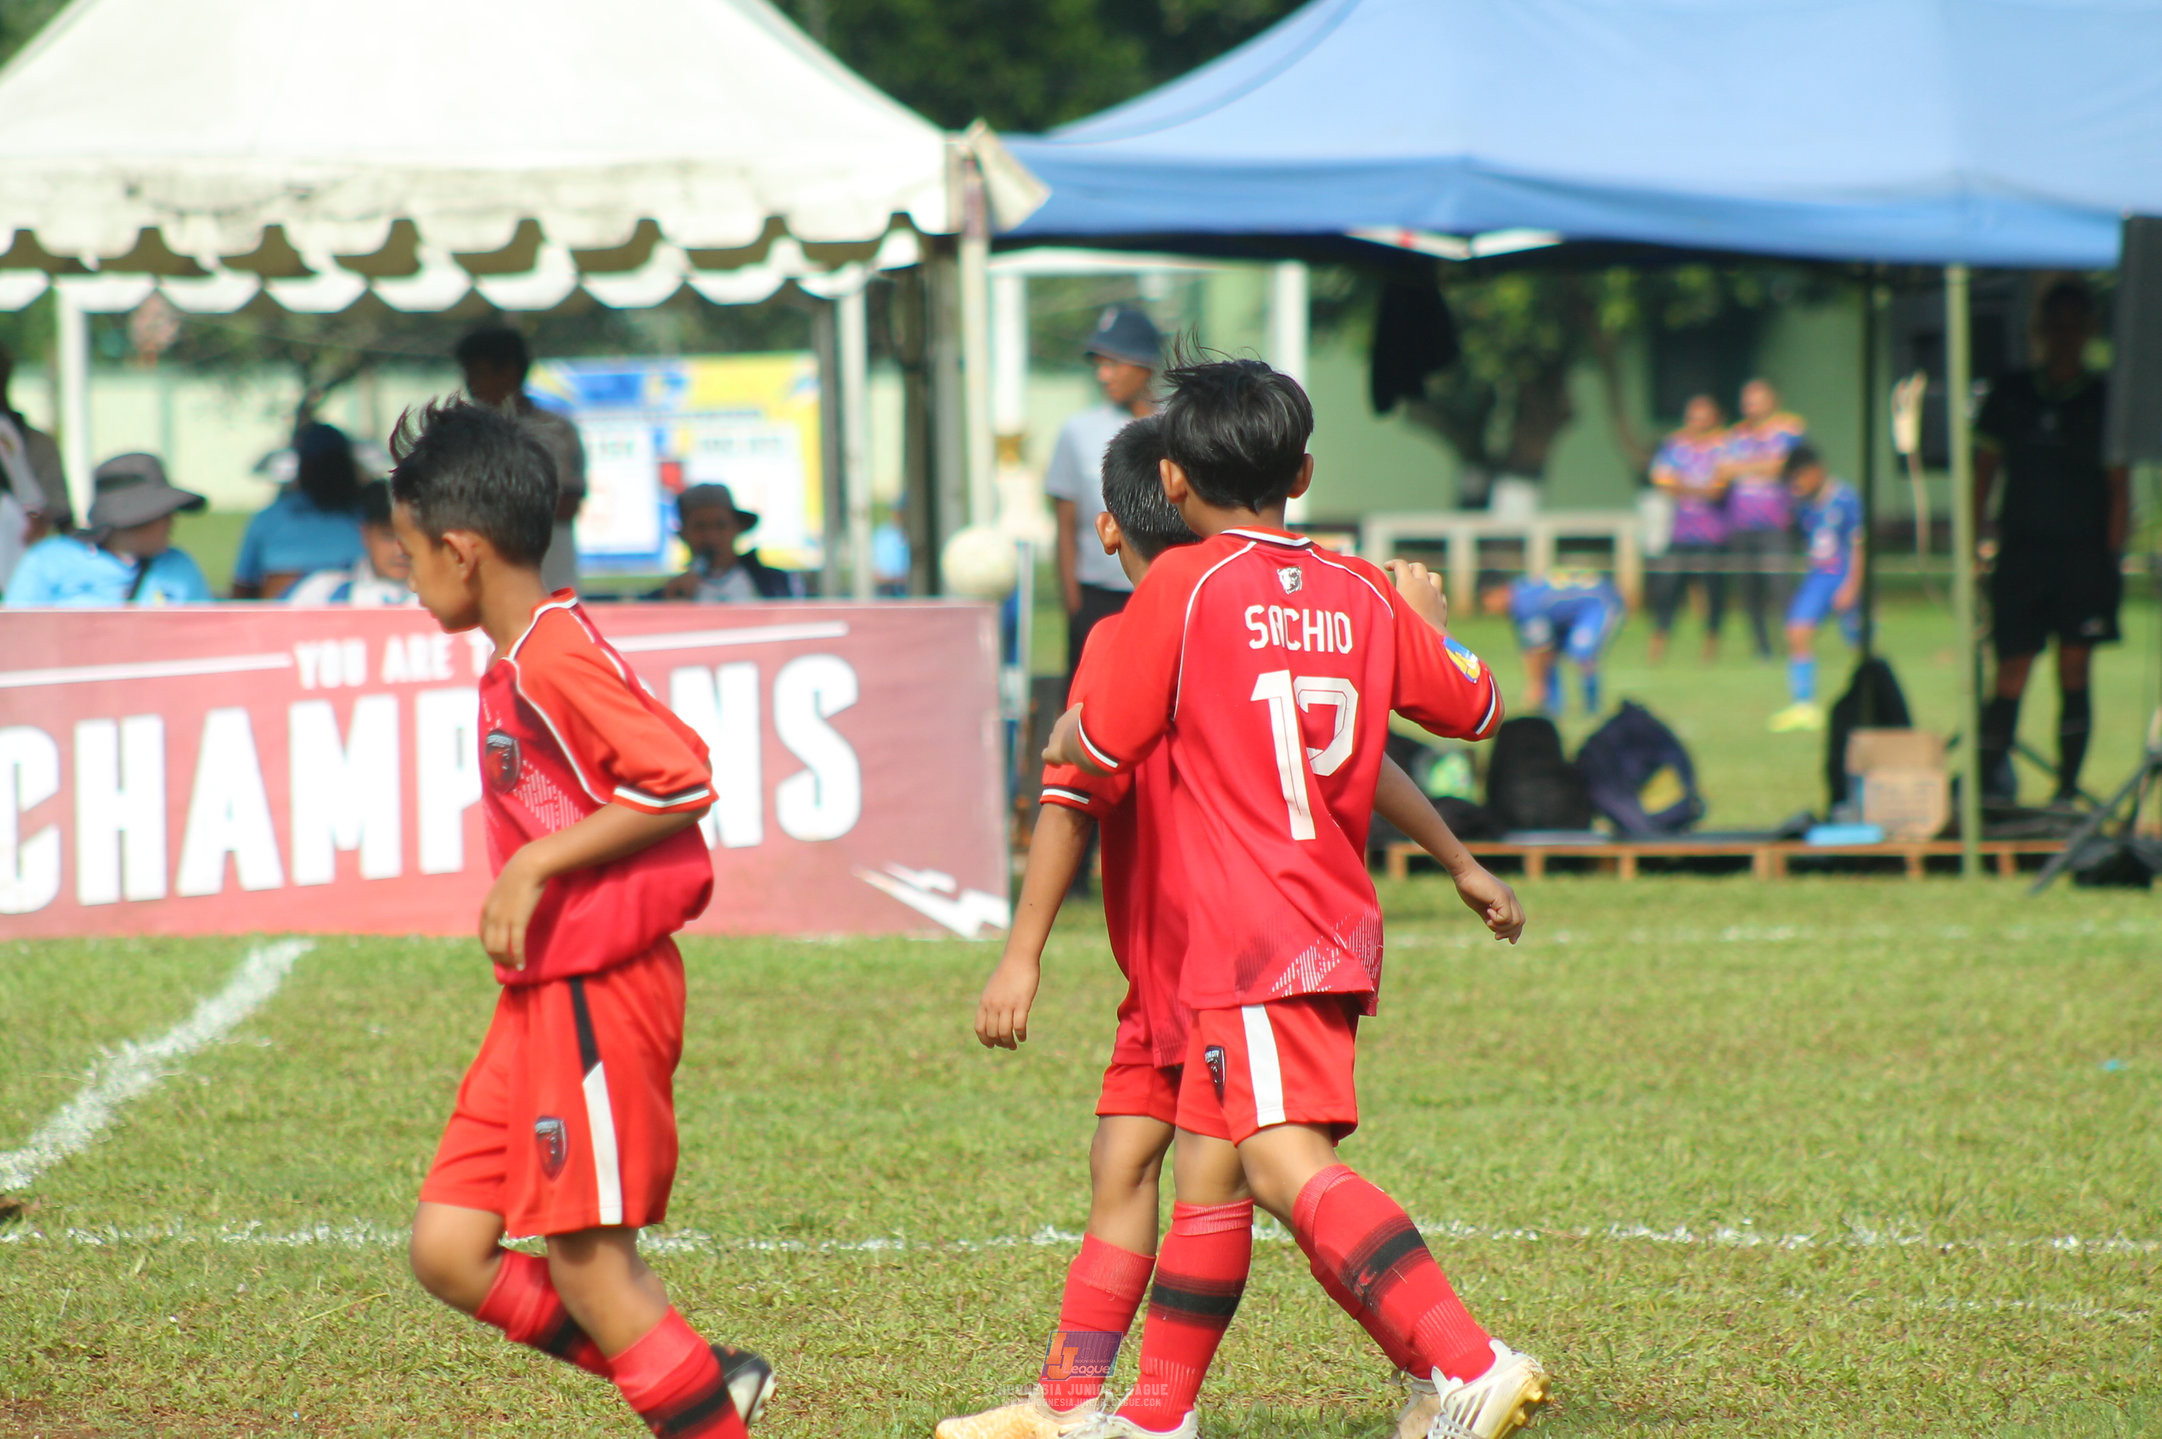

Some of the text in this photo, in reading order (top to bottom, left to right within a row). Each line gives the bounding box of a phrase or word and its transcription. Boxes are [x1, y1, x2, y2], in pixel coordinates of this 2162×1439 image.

[1245, 604, 1353, 654] SACHIO
[295, 636, 367, 690] YOU
[382, 630, 454, 684] ARE
